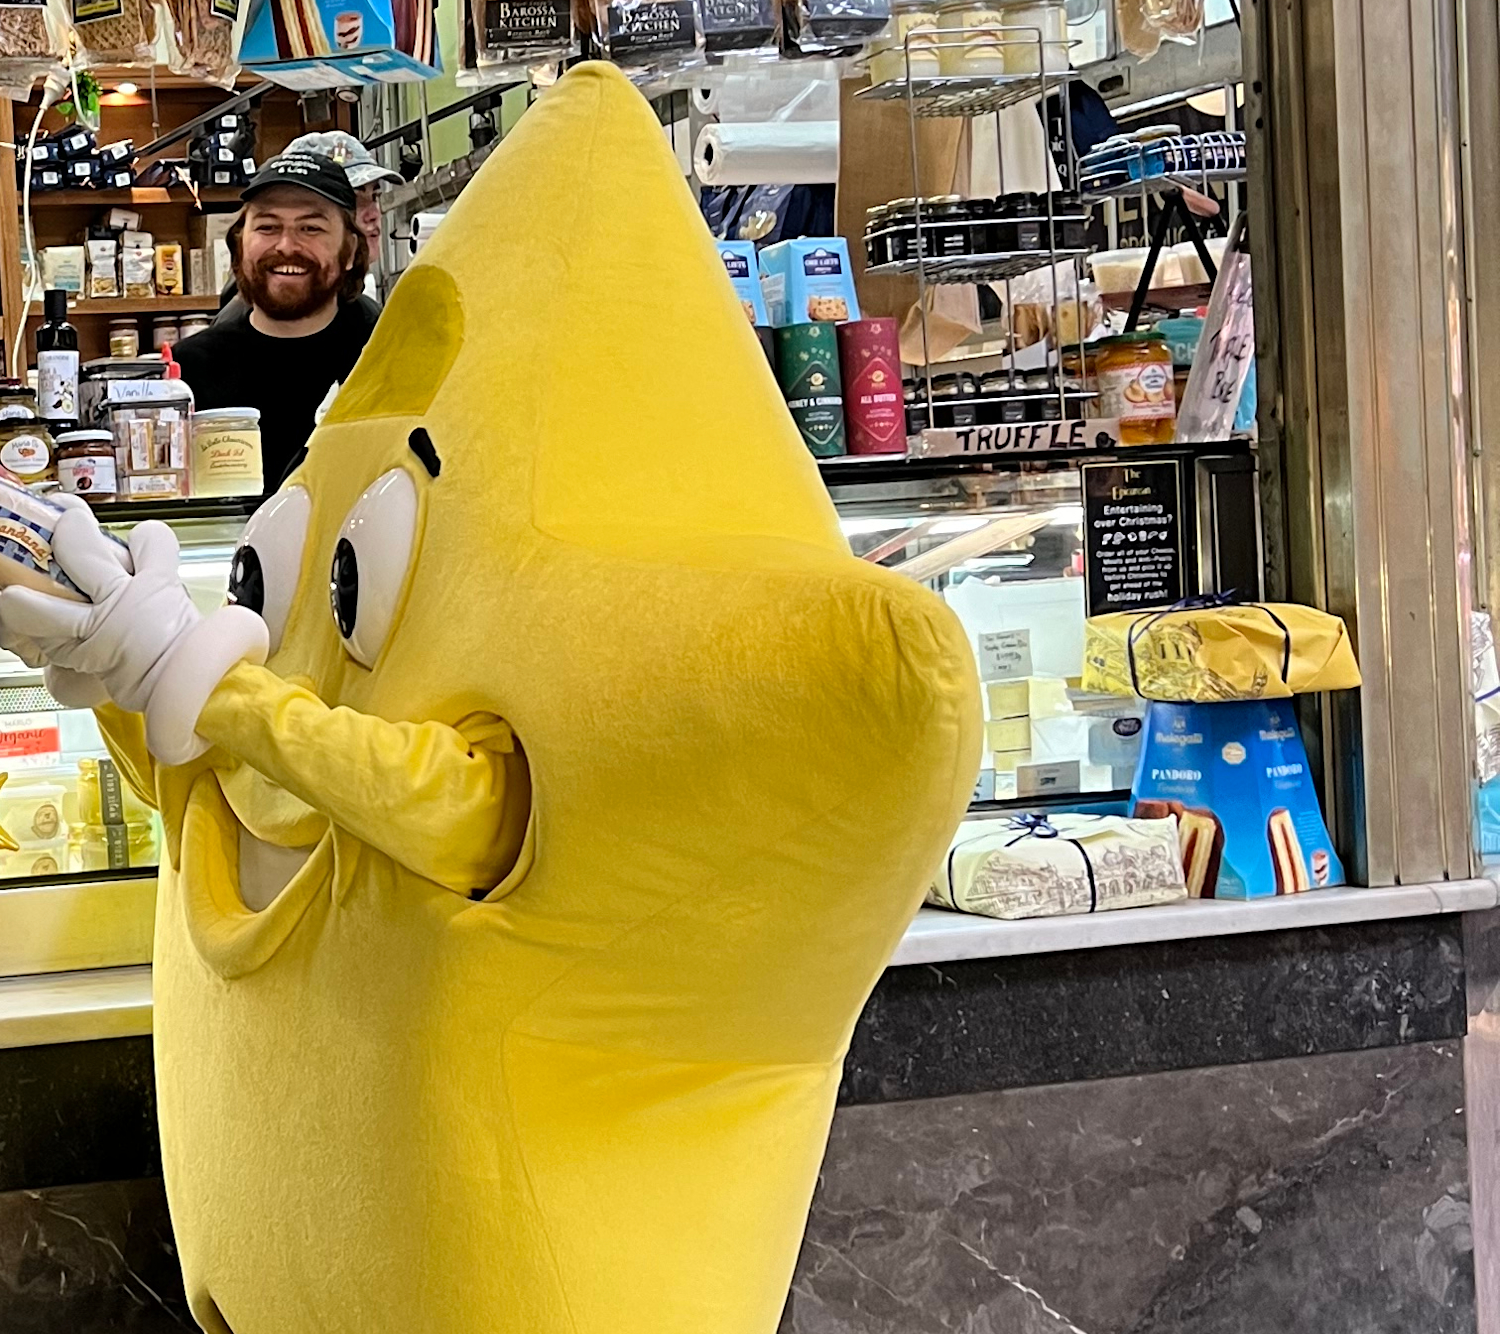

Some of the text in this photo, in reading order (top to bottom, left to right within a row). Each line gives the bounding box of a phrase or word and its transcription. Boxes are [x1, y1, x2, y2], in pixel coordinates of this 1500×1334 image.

[500, 2, 556, 19] BAROSSA
[500, 16, 557, 28] KITCHEN
[957, 420, 1087, 452] TRUFFLE
[1123, 468, 1142, 483] The
[1104, 503, 1163, 515] Entertaining
[1094, 514, 1173, 528] over Christmas?
[1107, 591, 1142, 602] holiday
[1152, 768, 1202, 782] PANDORO
